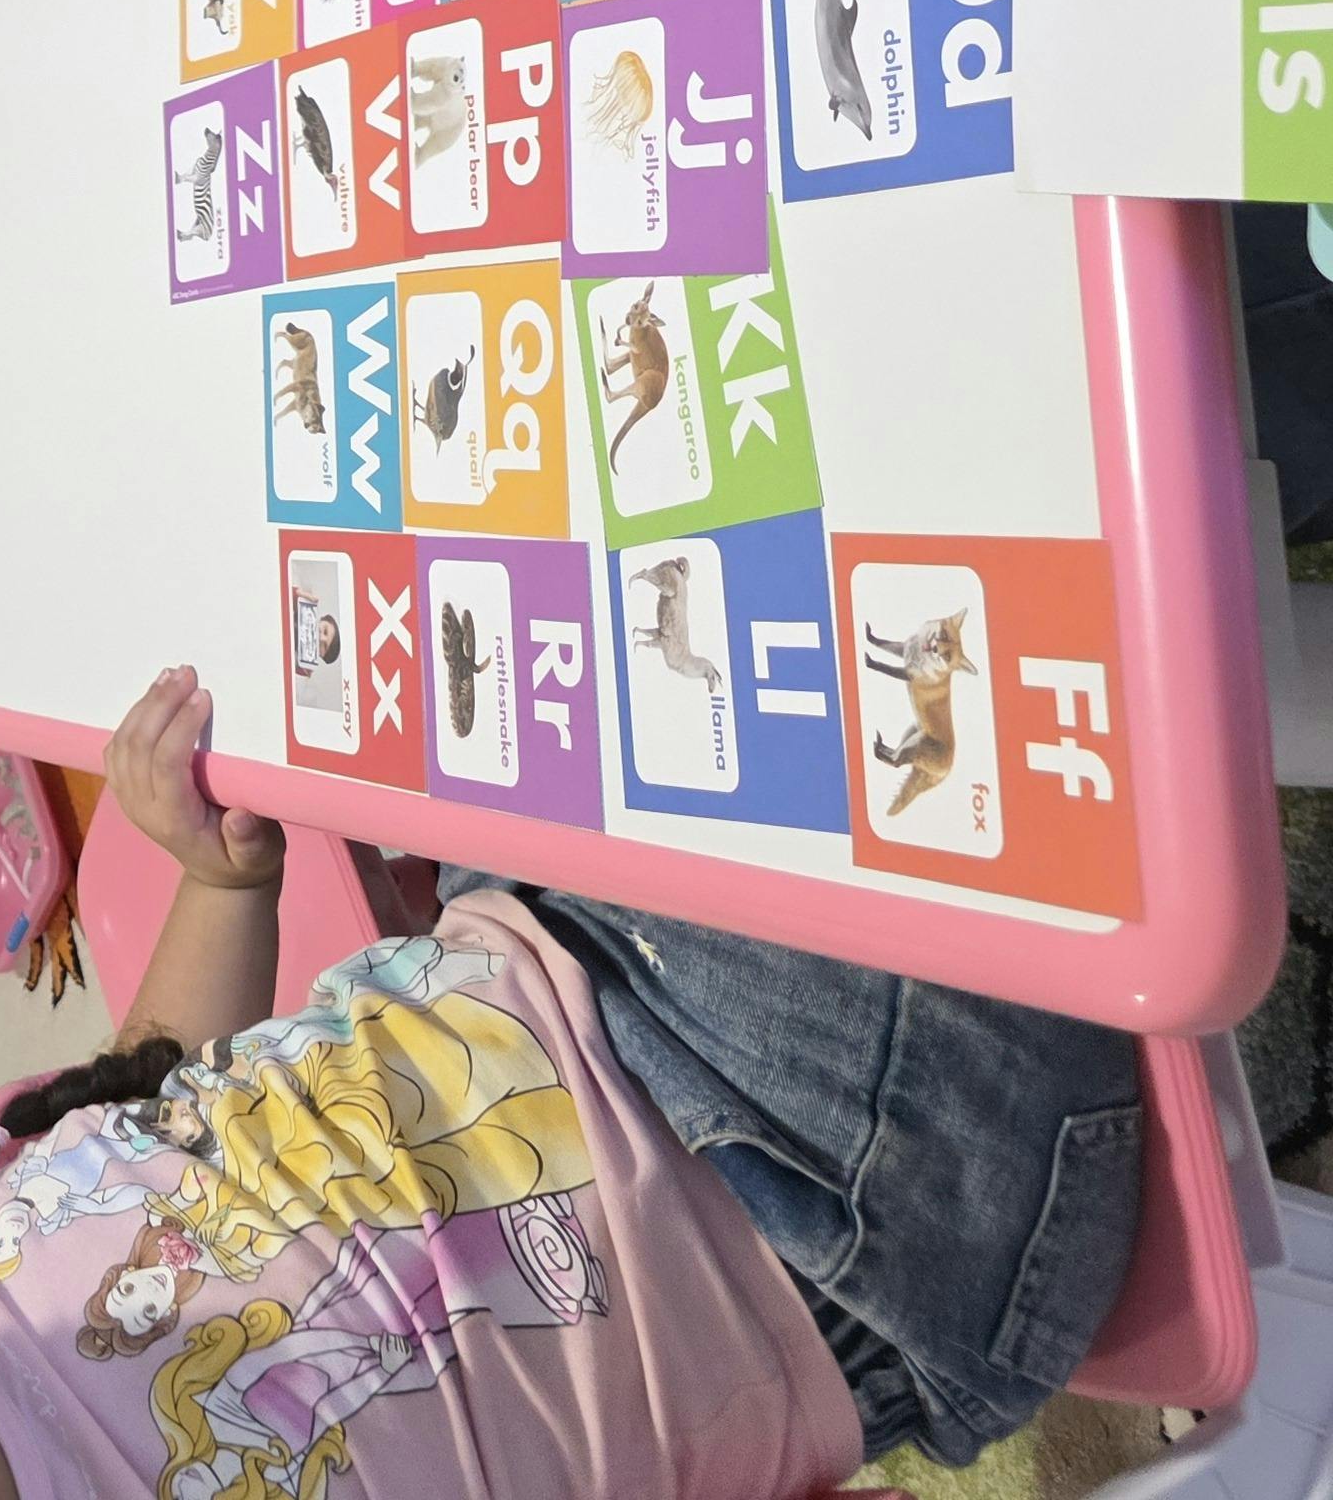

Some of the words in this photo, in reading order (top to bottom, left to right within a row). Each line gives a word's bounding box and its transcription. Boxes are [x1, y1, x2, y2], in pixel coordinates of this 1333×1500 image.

[226, 1, 237, 36] yak
[462, 94, 479, 155] polar
[484, 40, 553, 186] Pp
[666, 70, 753, 170] Jj
[878, 29, 904, 136] dolphin
[234, 118, 272, 238] Zz
[363, 75, 402, 212] Vv
[466, 158, 481, 211] bear
[640, 133, 659, 232] jellyfish
[213, 206, 228, 261] zebra
[337, 162, 352, 233] vulture
[343, 295, 392, 514] Ww
[480, 299, 554, 496] Qq
[705, 272, 790, 457] Kk
[318, 441, 335, 488] wolf
[462, 430, 483, 488] quail
[670, 355, 702, 481] kangaroo
[366, 576, 413, 736] Xx
[492, 634, 513, 769] rattlesnake
[527, 619, 584, 750] Rr
[749, 620, 826, 718] Ll
[339, 677, 355, 739] x-ray
[709, 695, 730, 771] llama
[1018, 655, 1111, 802] Ff
[968, 782, 989, 834] fox
